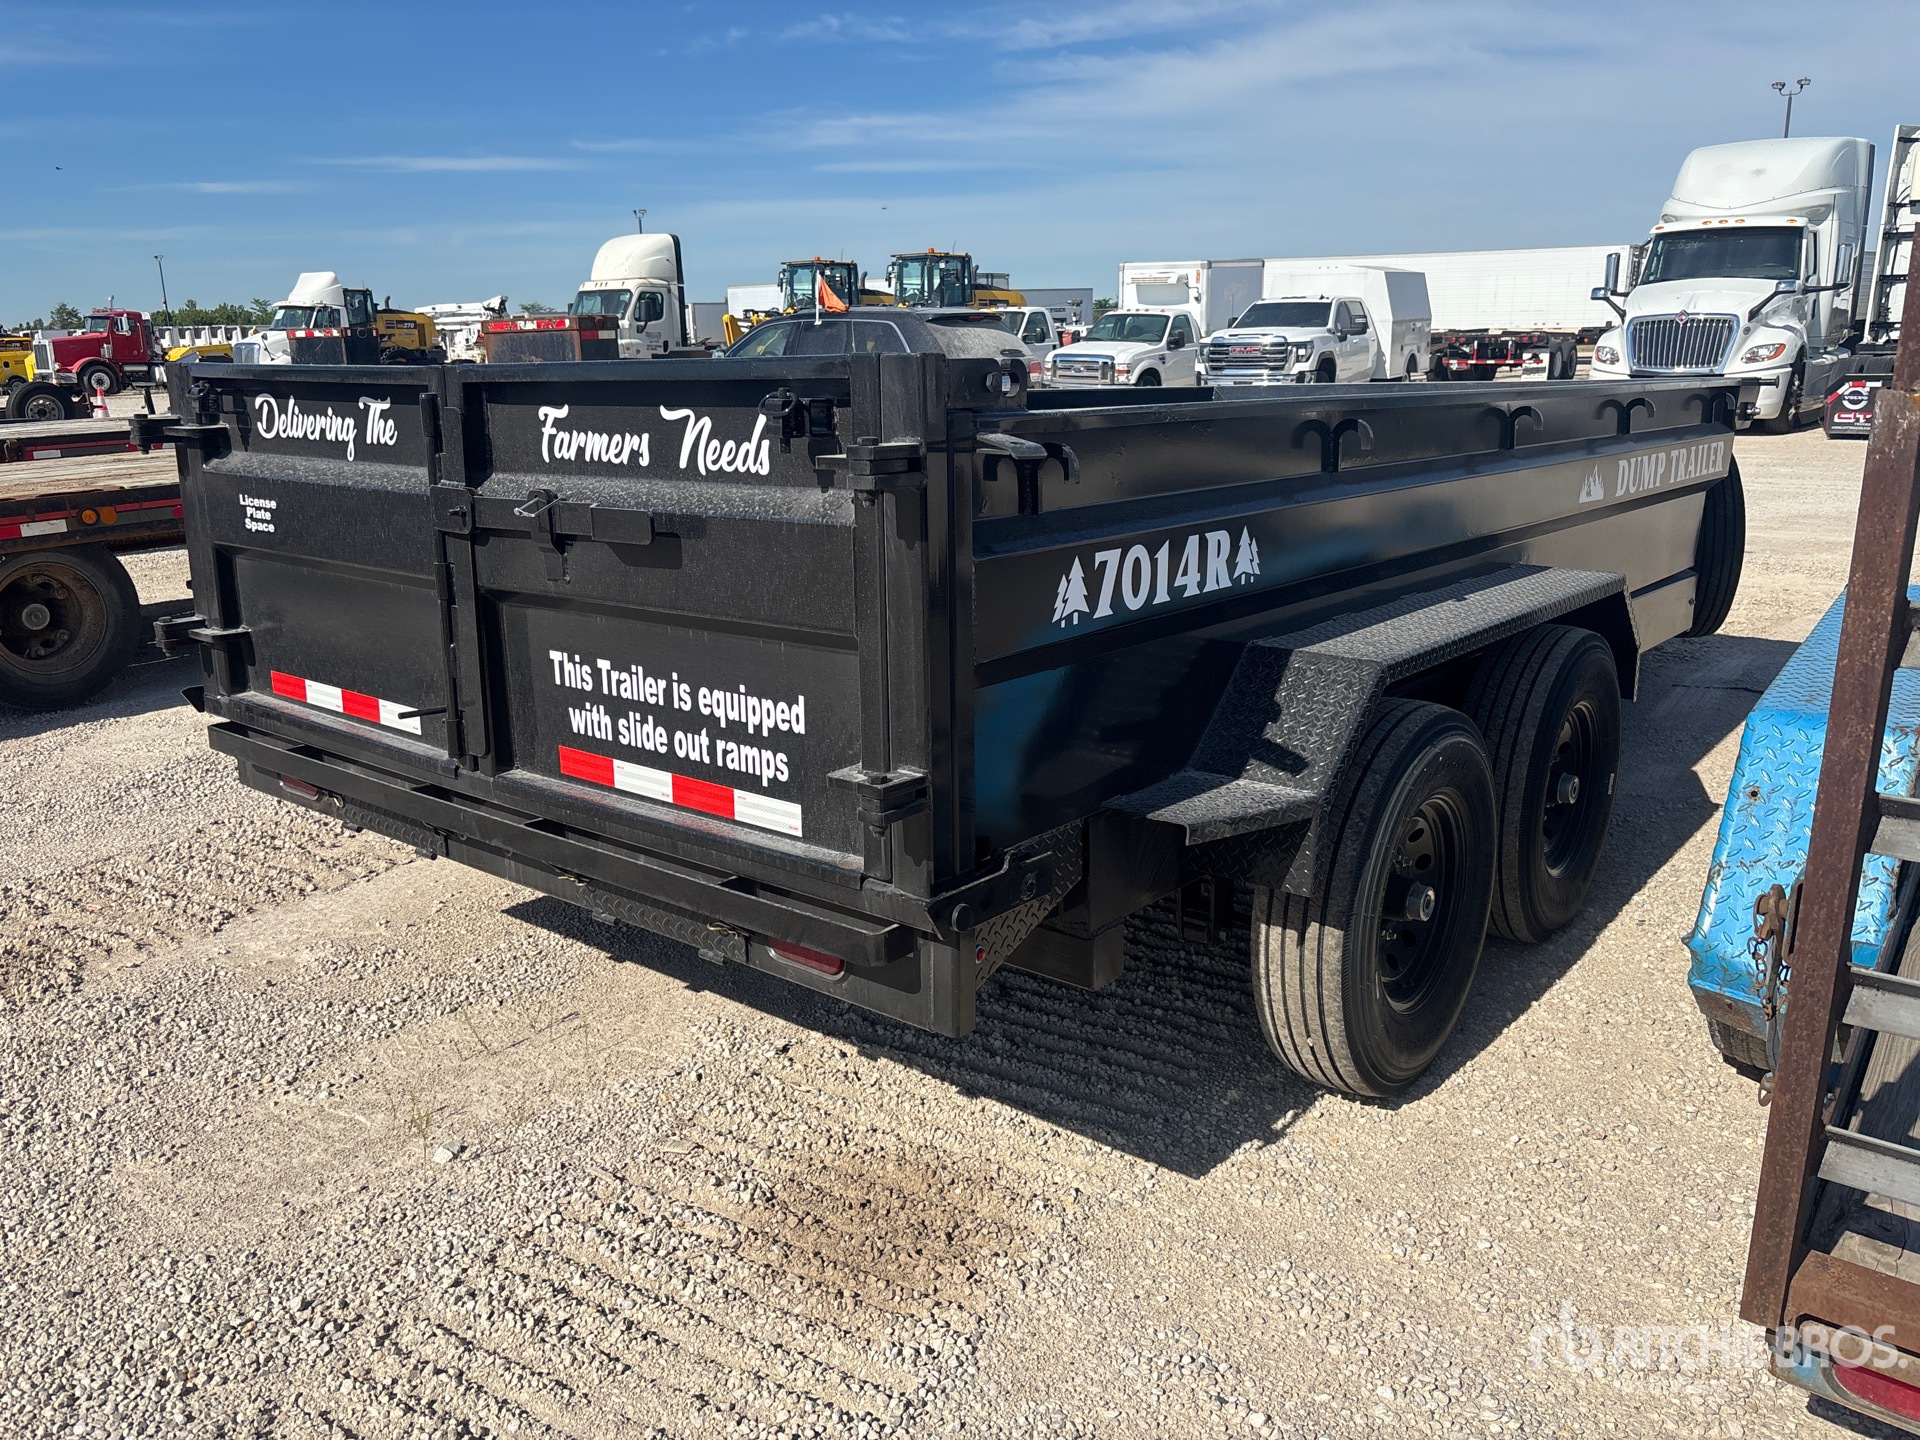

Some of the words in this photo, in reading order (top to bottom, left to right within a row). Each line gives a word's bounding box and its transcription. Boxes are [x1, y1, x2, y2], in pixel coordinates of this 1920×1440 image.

[1231, 346, 1261, 354] GMC
[254, 393, 357, 462] Delivering
[358, 396, 398, 446] The
[537, 403, 650, 467] Farmers
[659, 404, 770, 476] Needs
[1613, 452, 1667, 498] DUMP
[1668, 441, 1725, 484] TRAILER
[239, 493, 277, 510] License
[244, 518, 275, 533] Space
[246, 506, 272, 520] Plate
[1092, 529, 1234, 619] 7014R
[548, 649, 594, 692] This
[596, 658, 667, 706] Trailer
[671, 671, 692, 712] is
[697, 684, 806, 738] equipped
[568, 701, 613, 742] with
[617, 710, 668, 754] slide
[673, 727, 711, 765] out
[715, 739, 790, 787] ramps
